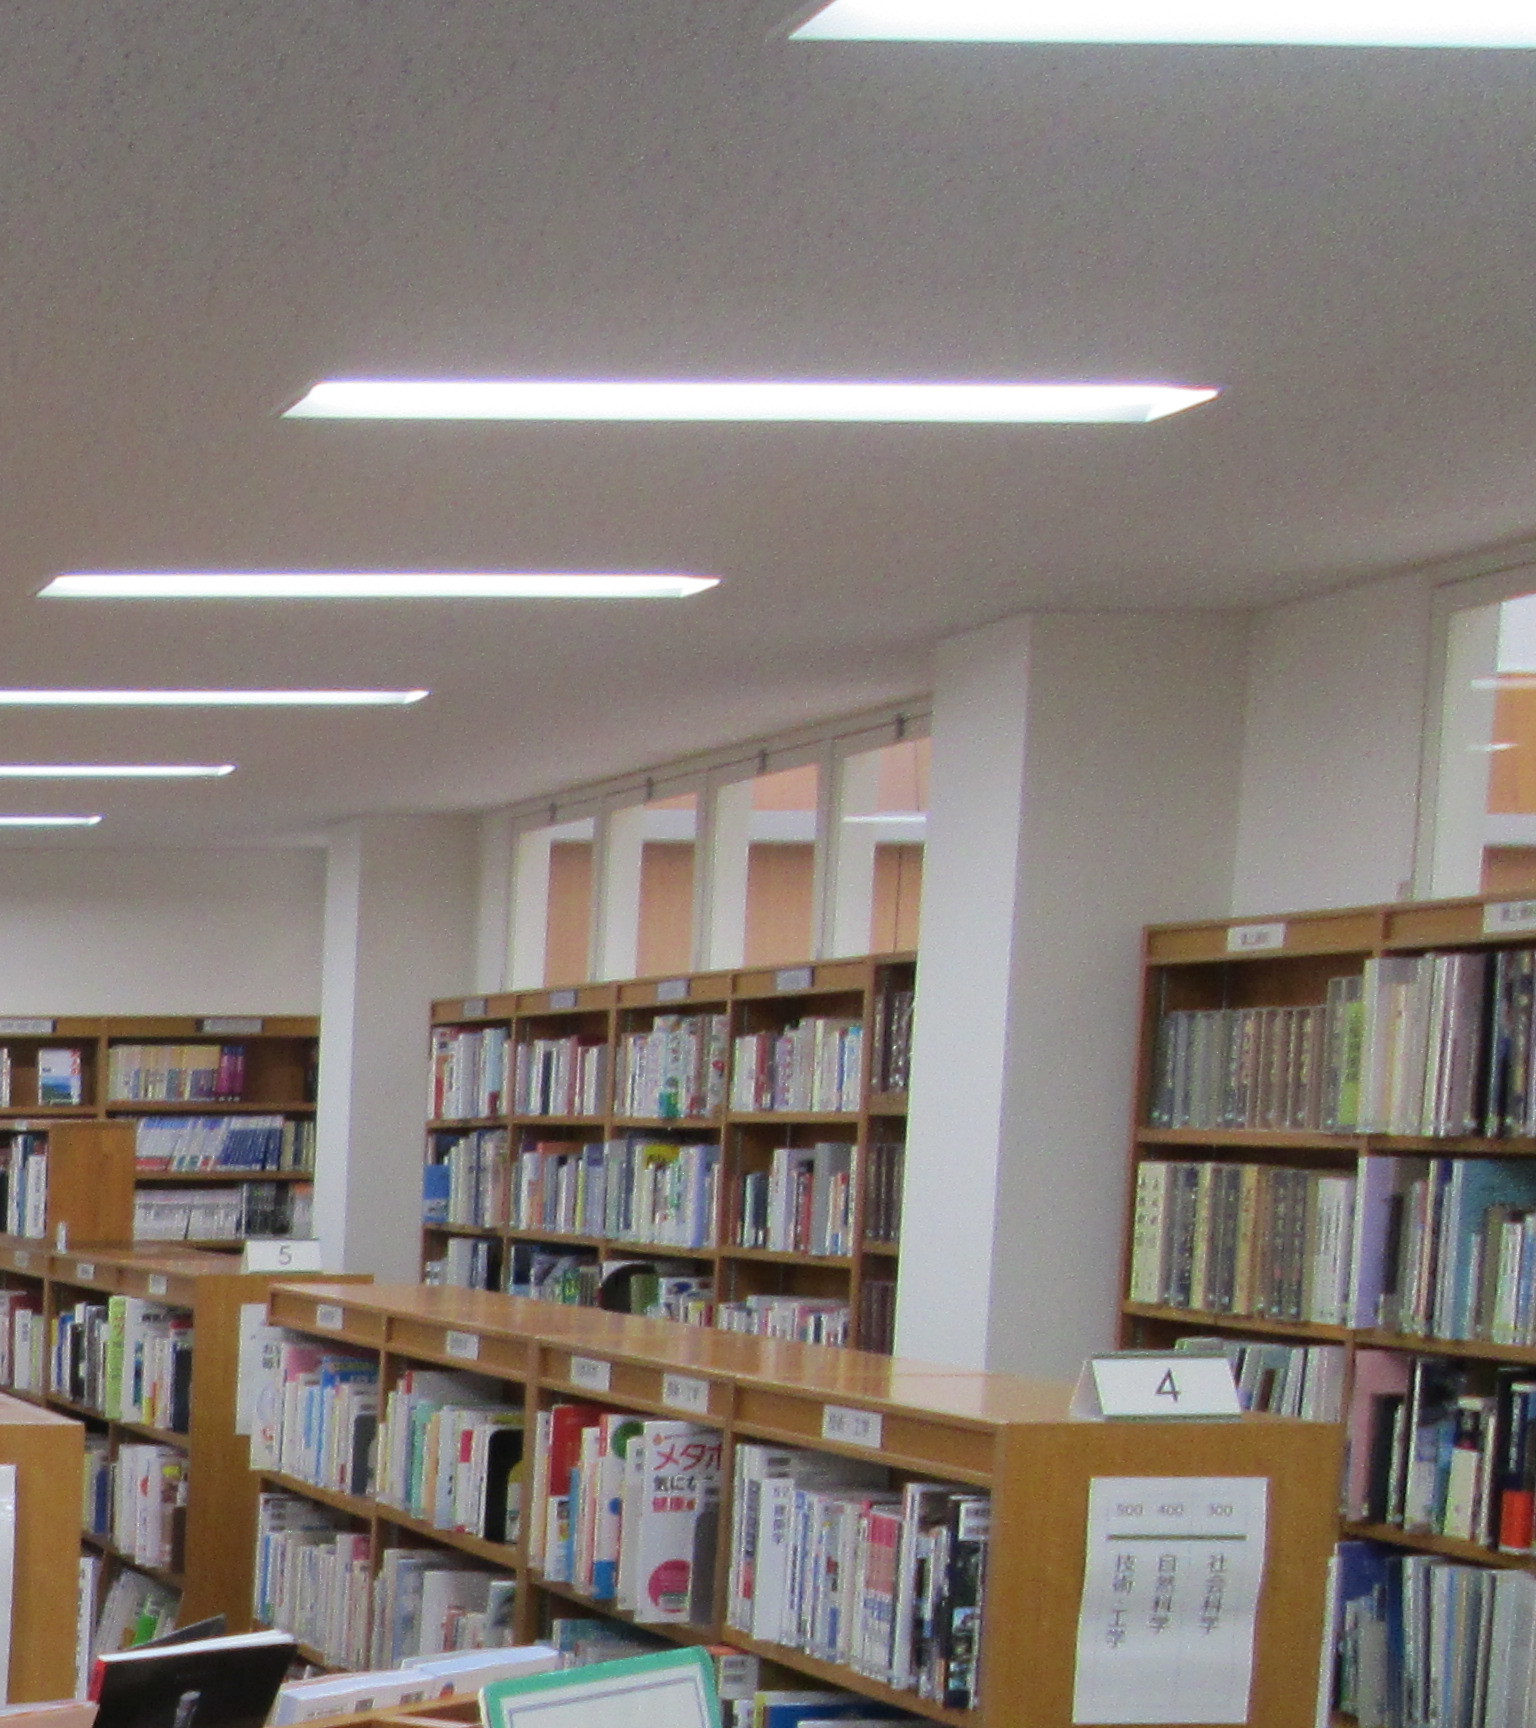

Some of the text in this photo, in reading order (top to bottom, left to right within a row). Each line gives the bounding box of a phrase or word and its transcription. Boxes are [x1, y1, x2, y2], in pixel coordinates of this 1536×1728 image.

[277, 1244, 291, 1264] 5
[1155, 1368, 1181, 1402] 4
[1115, 1503, 1144, 1517] 500
[1156, 1503, 1184, 1517] 400
